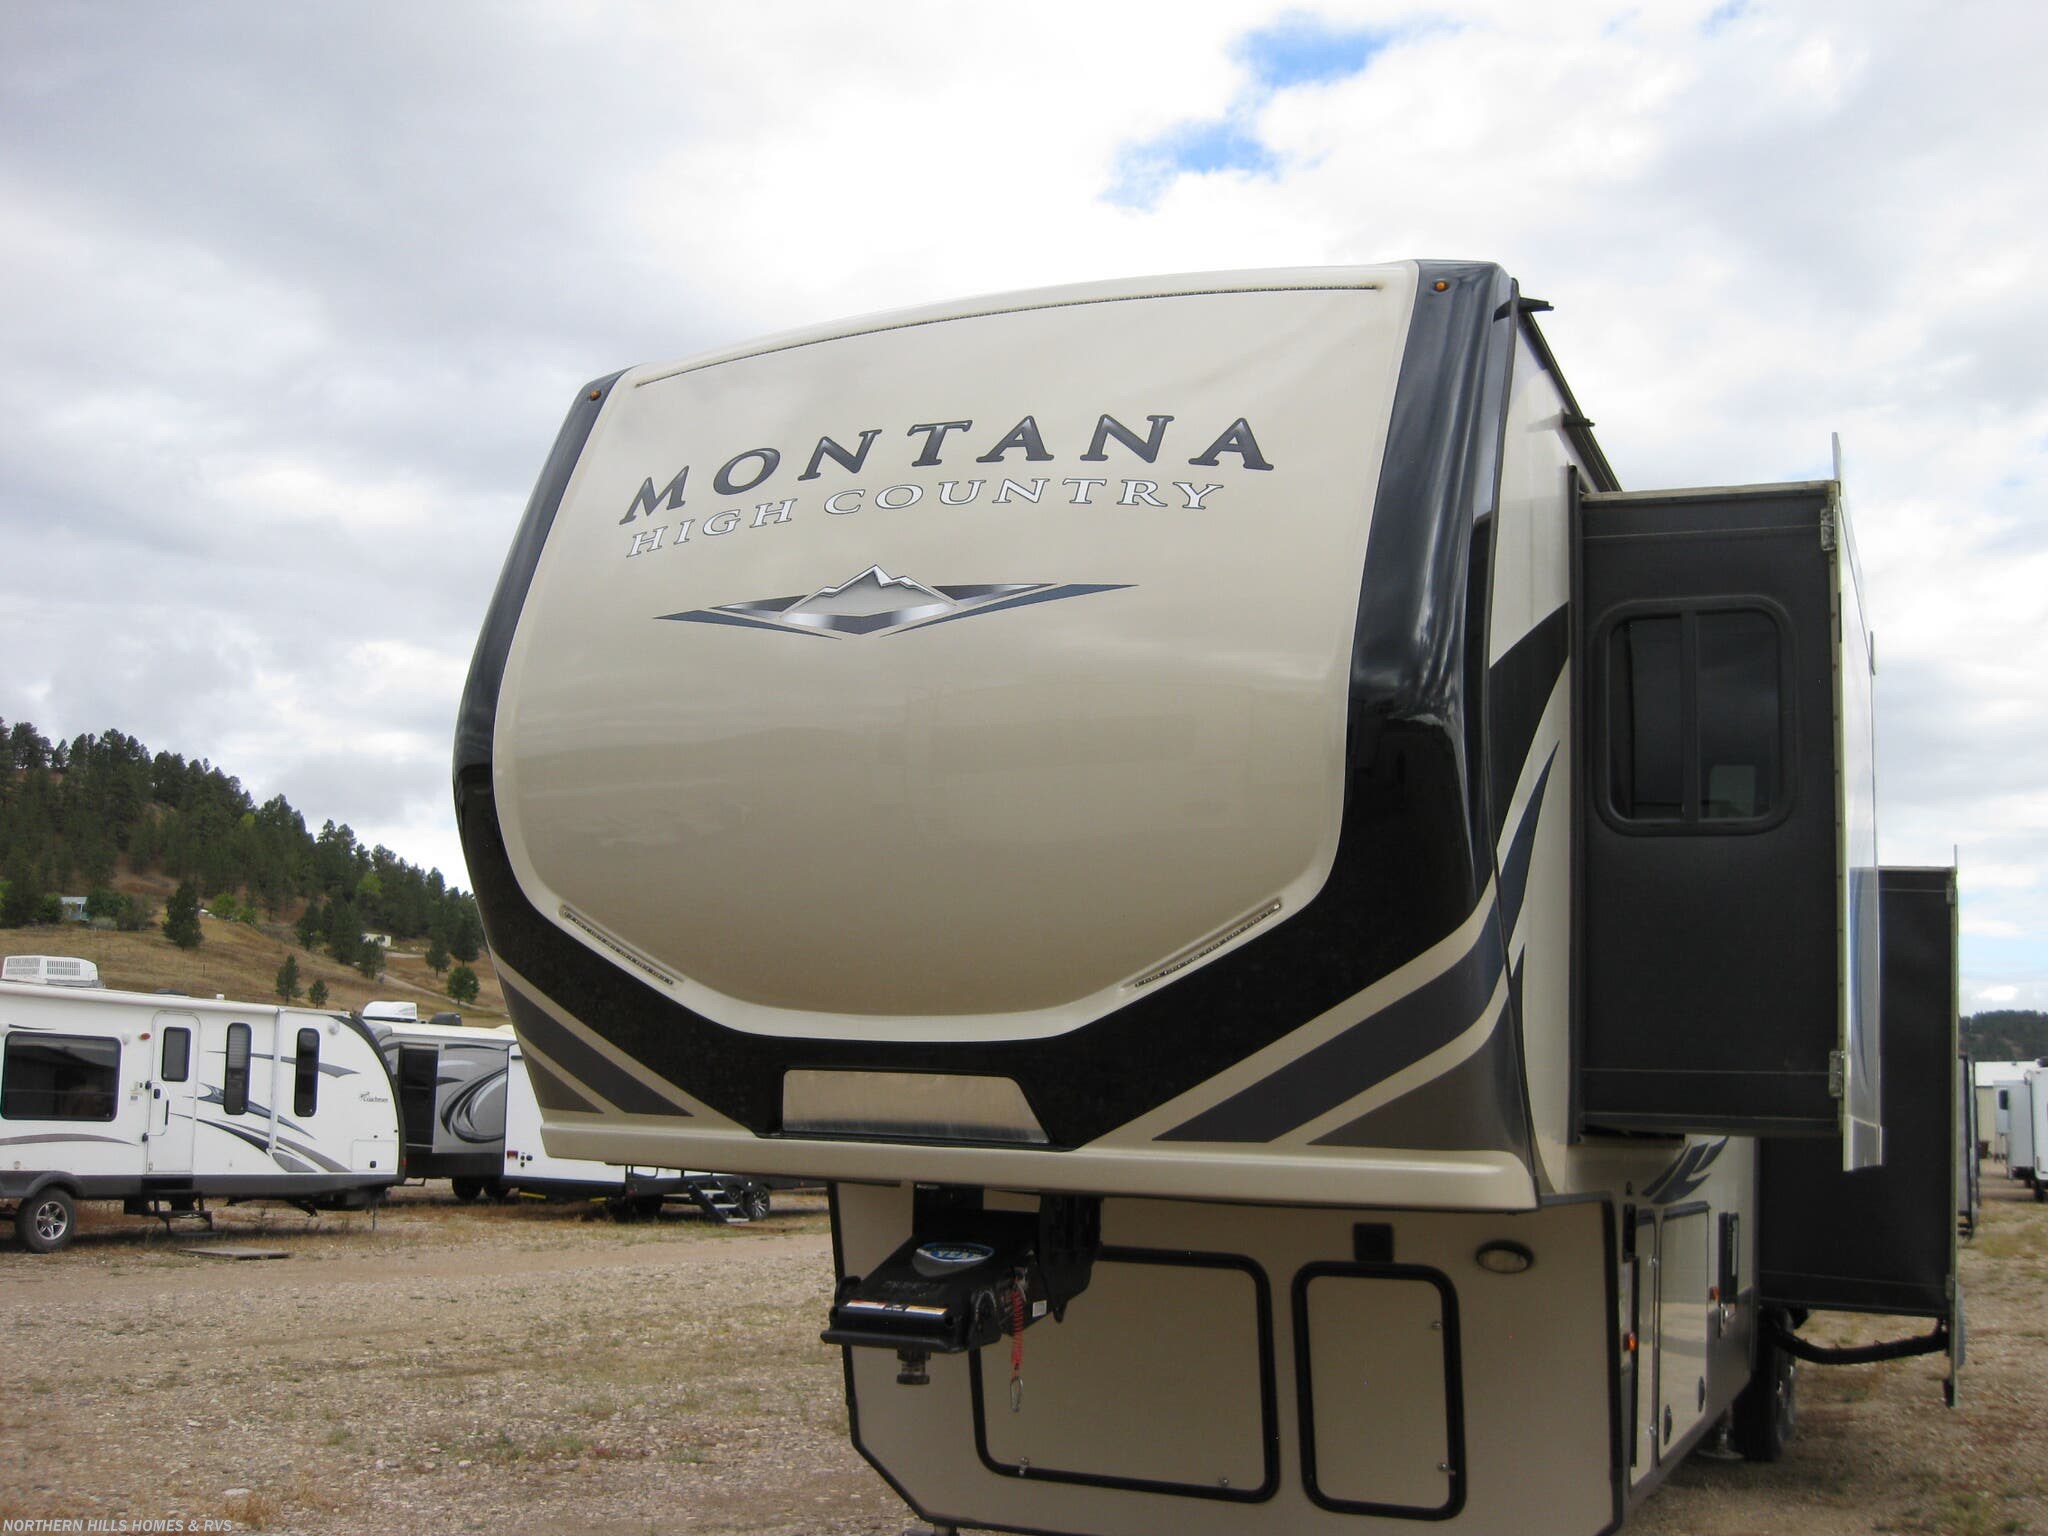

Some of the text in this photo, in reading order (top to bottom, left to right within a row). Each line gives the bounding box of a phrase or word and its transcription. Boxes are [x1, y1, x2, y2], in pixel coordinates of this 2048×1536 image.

[619, 414, 1274, 526] MONTANA
[626, 477, 1224, 558] HIGH COUNTRY
